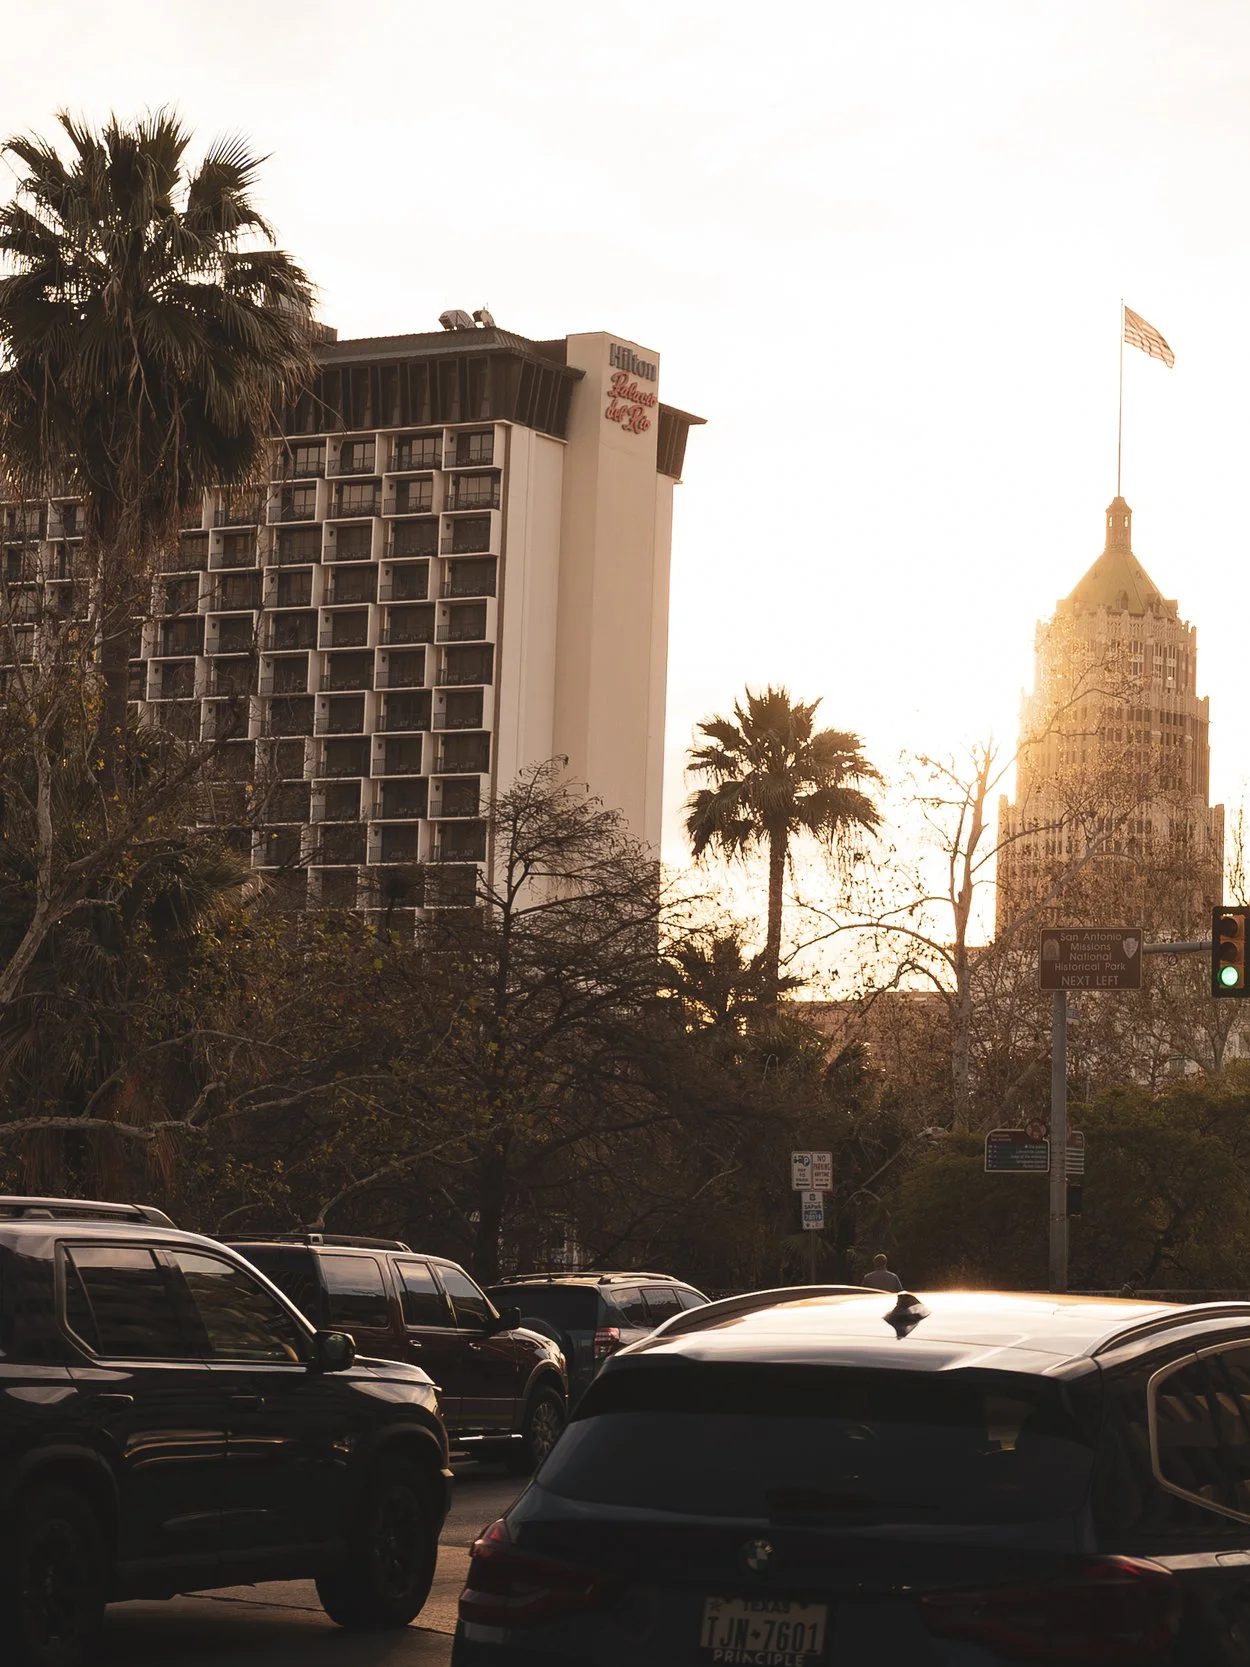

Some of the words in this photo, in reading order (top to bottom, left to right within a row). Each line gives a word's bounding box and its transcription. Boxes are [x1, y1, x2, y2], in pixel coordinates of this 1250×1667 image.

[609, 343, 657, 382] Hilton
[1060, 932, 1079, 941] San
[1084, 932, 1122, 941] Antonio
[1070, 943, 1111, 951] Missions
[1069, 952, 1112, 961] National
[1054, 962, 1100, 971] Historical
[1105, 962, 1126, 971] Park
[1061, 975, 1090, 986] NEXT
[1096, 975, 1119, 986] LEFT
[744, 1601, 791, 1614] TEXAS
[713, 1649, 805, 1667] PRINCIPLE
